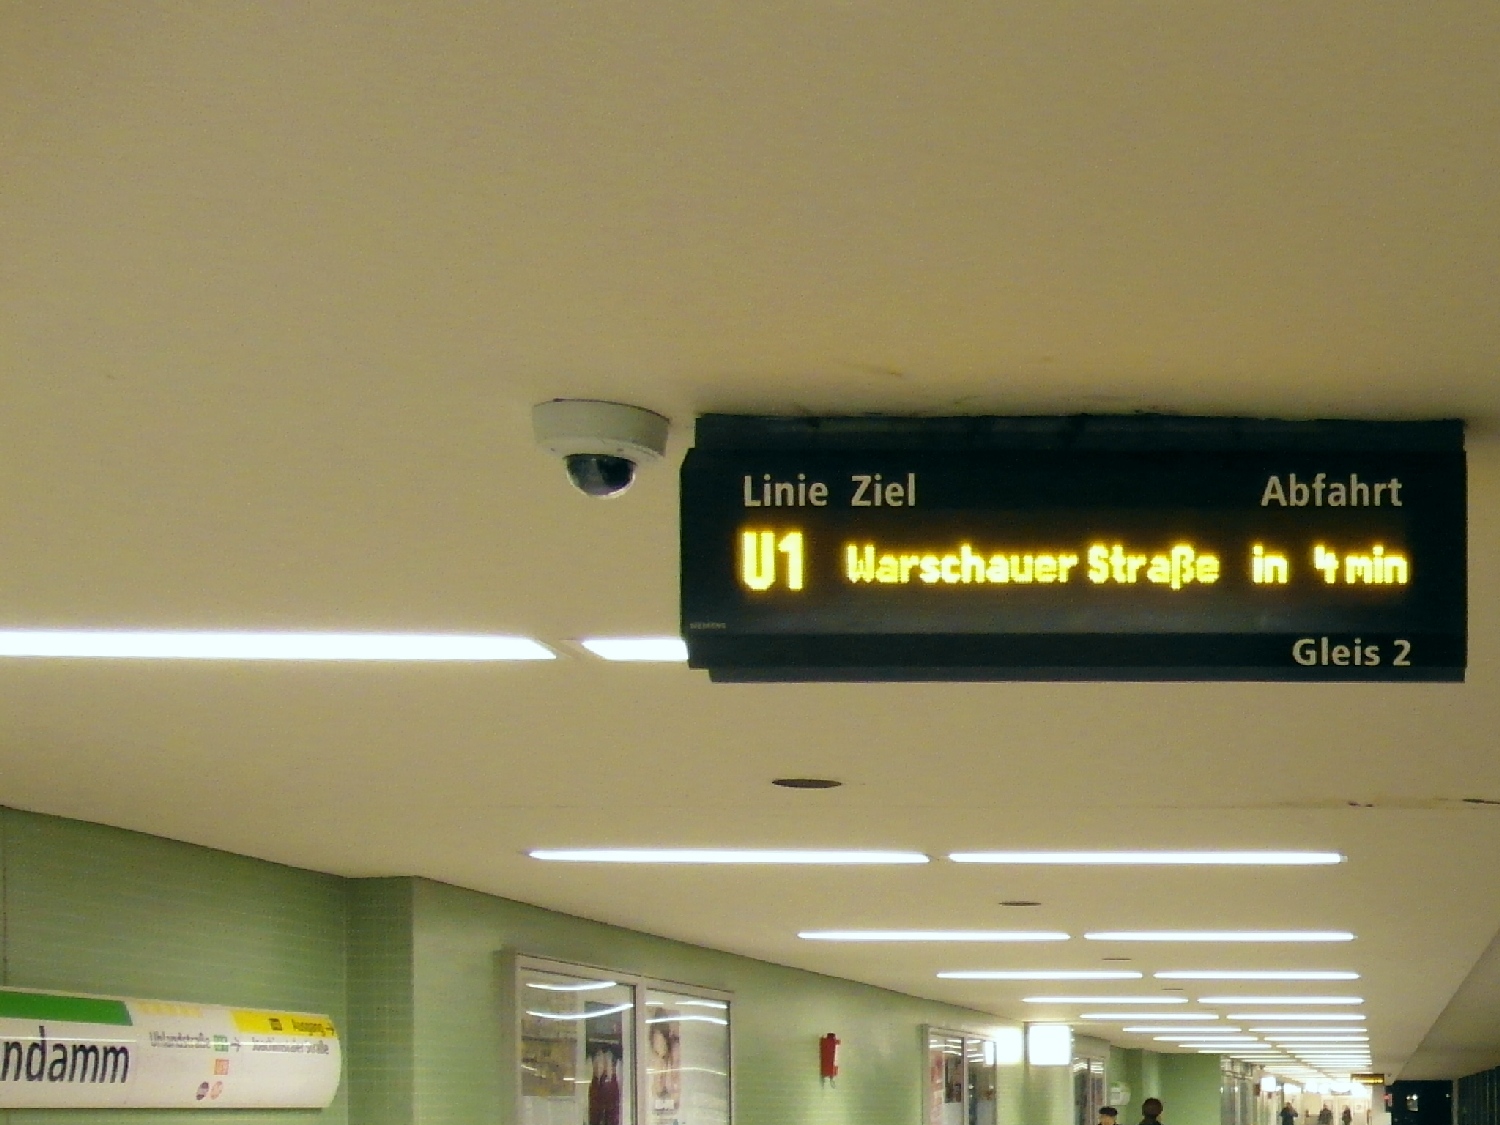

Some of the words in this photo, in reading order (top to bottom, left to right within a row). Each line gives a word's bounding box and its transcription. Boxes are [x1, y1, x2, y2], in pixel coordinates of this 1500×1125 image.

[743, 473, 829, 507] Linie
[851, 473, 916, 507] Ziel
[1260, 472, 1403, 507] Abfahrt
[742, 530, 804, 591] U1
[846, 543, 1078, 583] Warschauer
[1087, 545, 1220, 589] Straße
[1252, 545, 1289, 584] in
[1313, 545, 1338, 584] 4
[1346, 545, 1408, 584] min
[1292, 636, 1381, 666] Gleis
[1392, 639, 1411, 666] 2
[0, 1026, 130, 1084] ndamm
